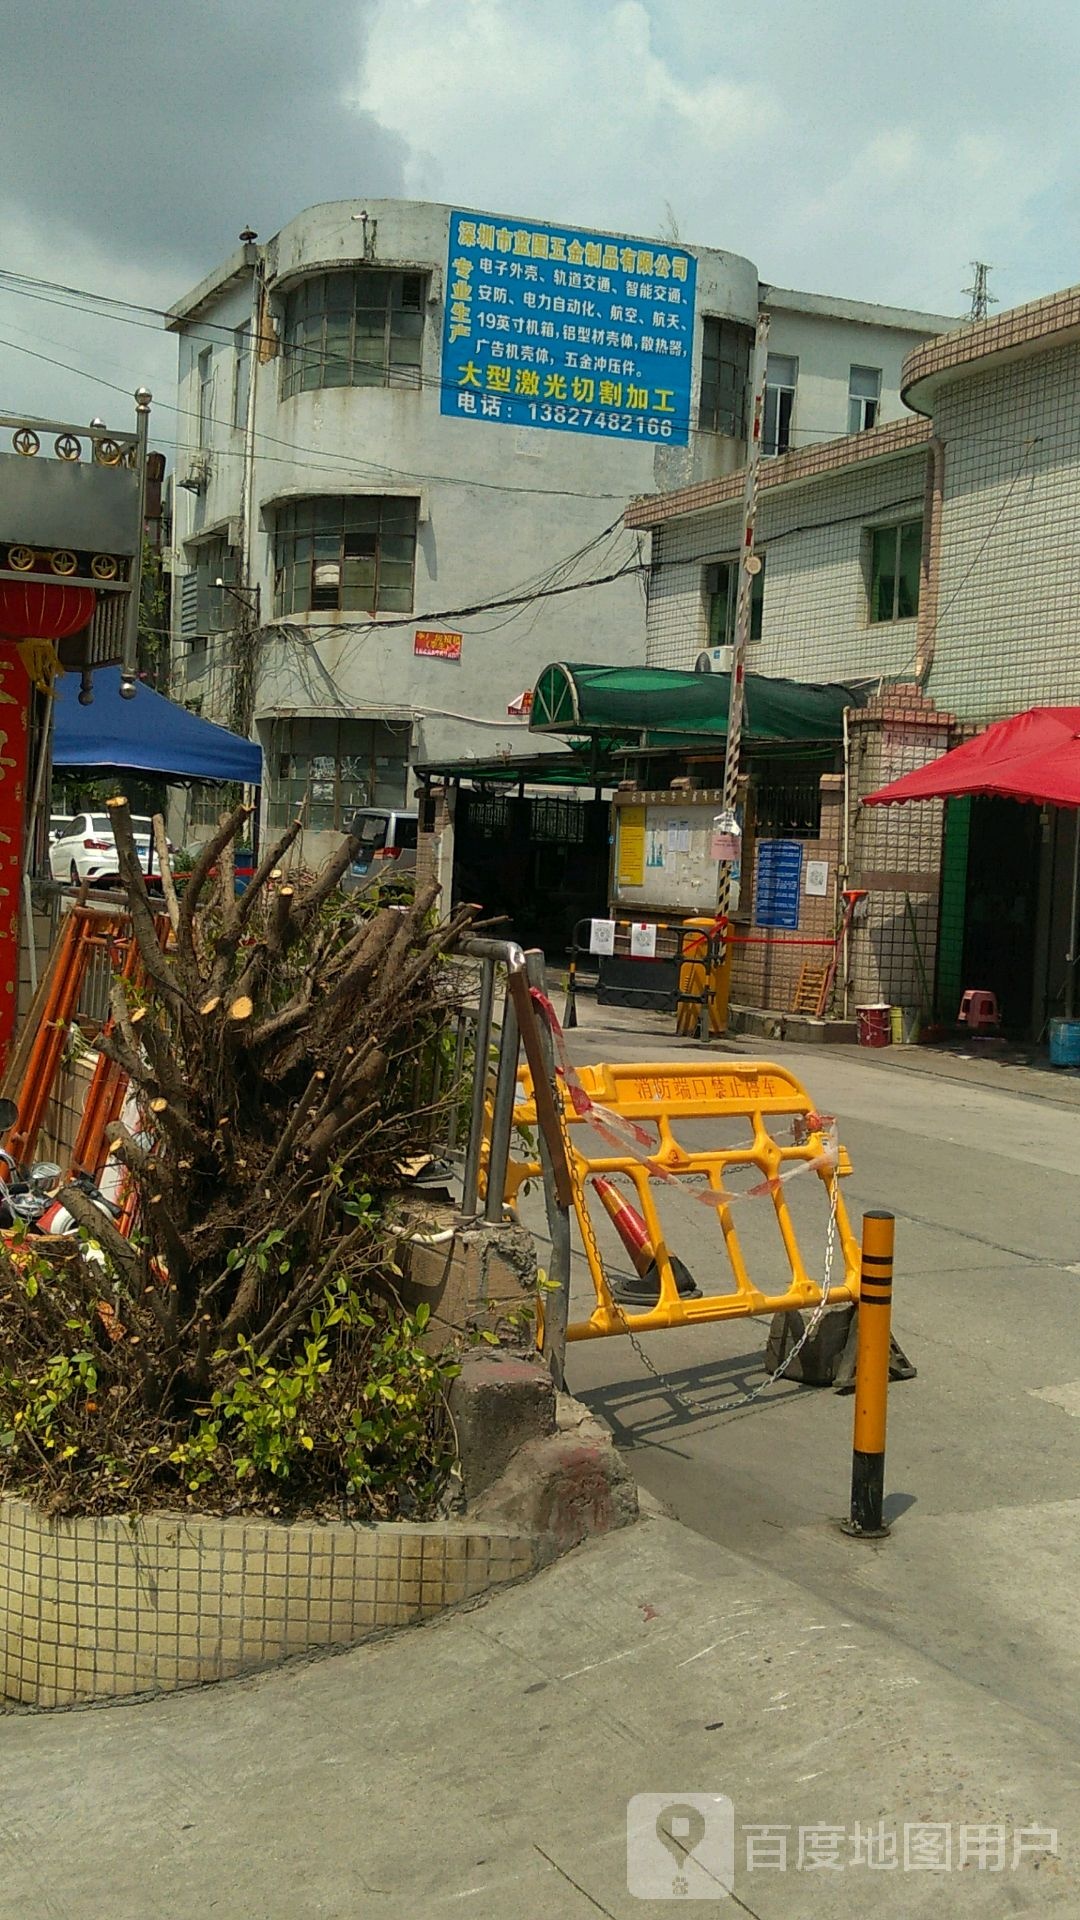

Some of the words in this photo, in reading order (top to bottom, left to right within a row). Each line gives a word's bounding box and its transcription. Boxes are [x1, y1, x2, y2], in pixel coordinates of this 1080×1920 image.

[458, 220, 689, 282] 深圳市蓝图五金制品有限公司
[448, 257, 475, 344] 专业生产
[457, 360, 675, 412] 大型激光切割加工
